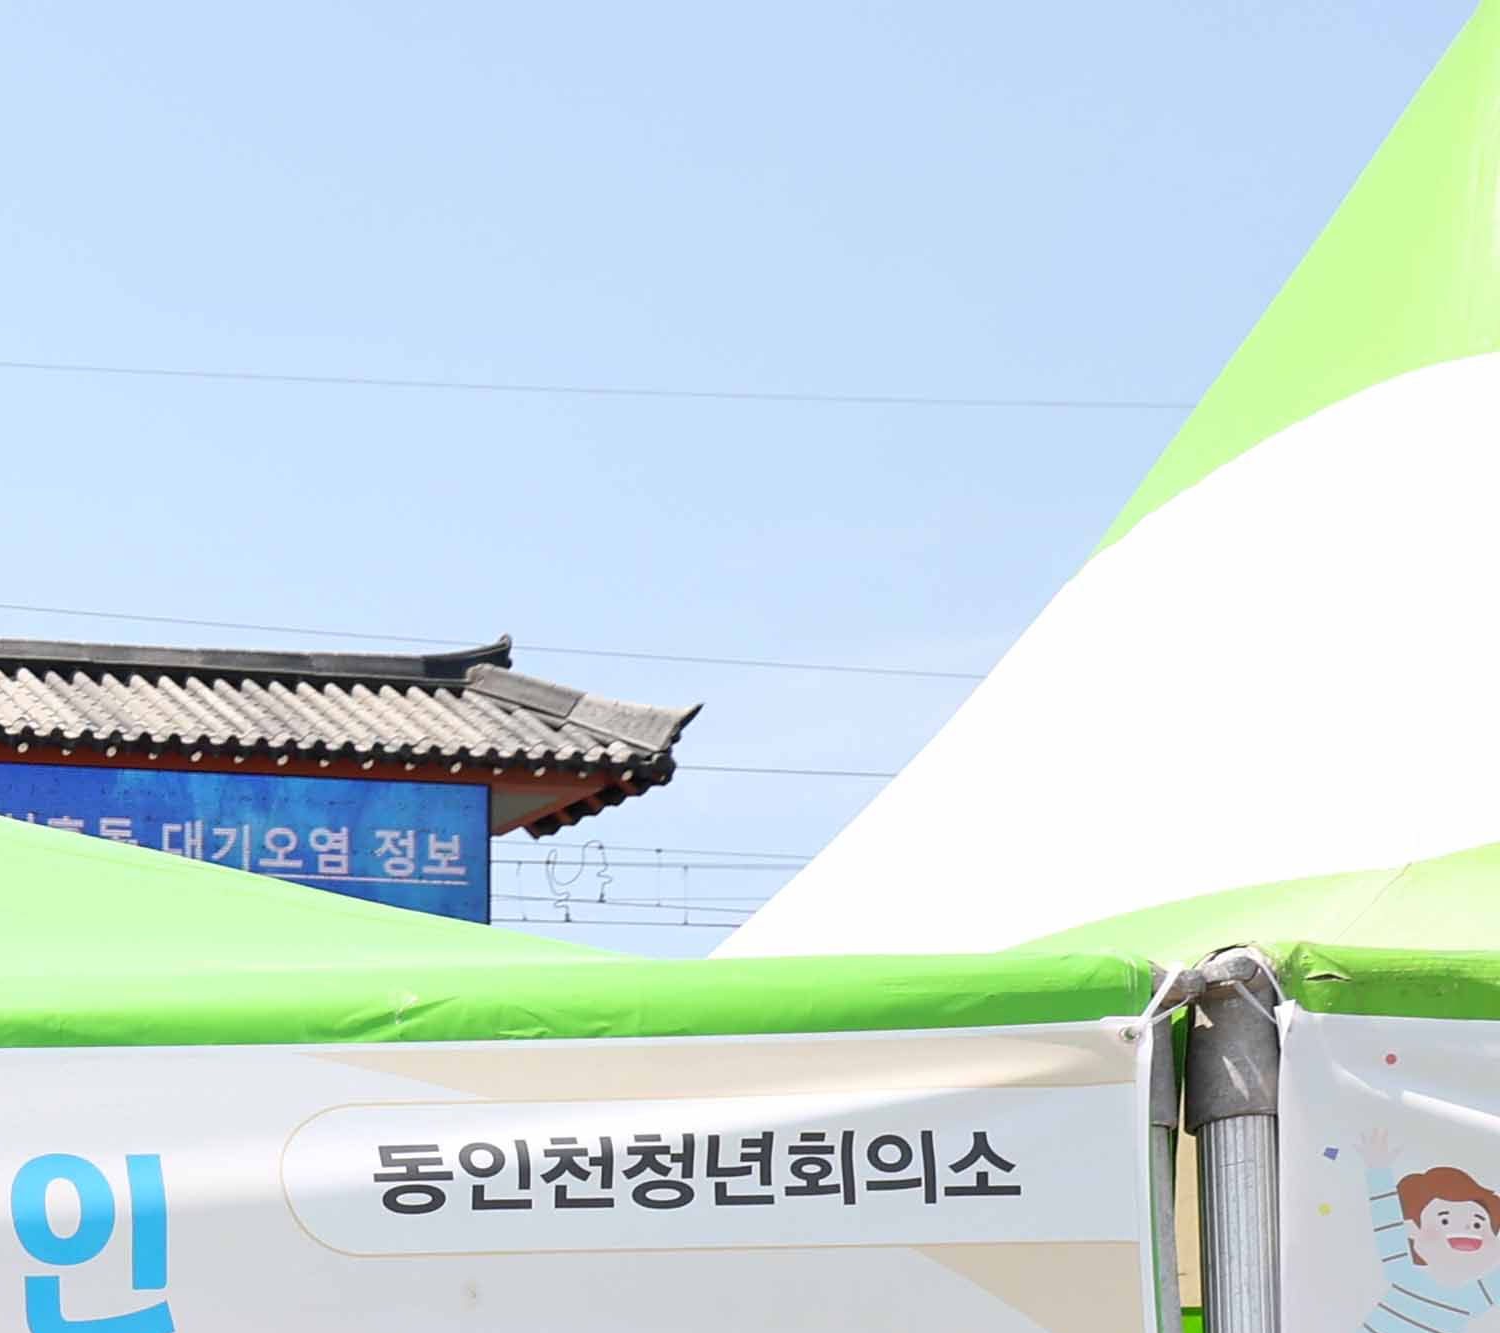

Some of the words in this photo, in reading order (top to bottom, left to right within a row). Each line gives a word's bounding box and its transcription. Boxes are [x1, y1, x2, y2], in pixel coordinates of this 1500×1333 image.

[162, 820, 350, 876] 대기오염
[374, 827, 468, 878] 정보
[370, 1130, 1023, 1214] 동인천청년회의소
